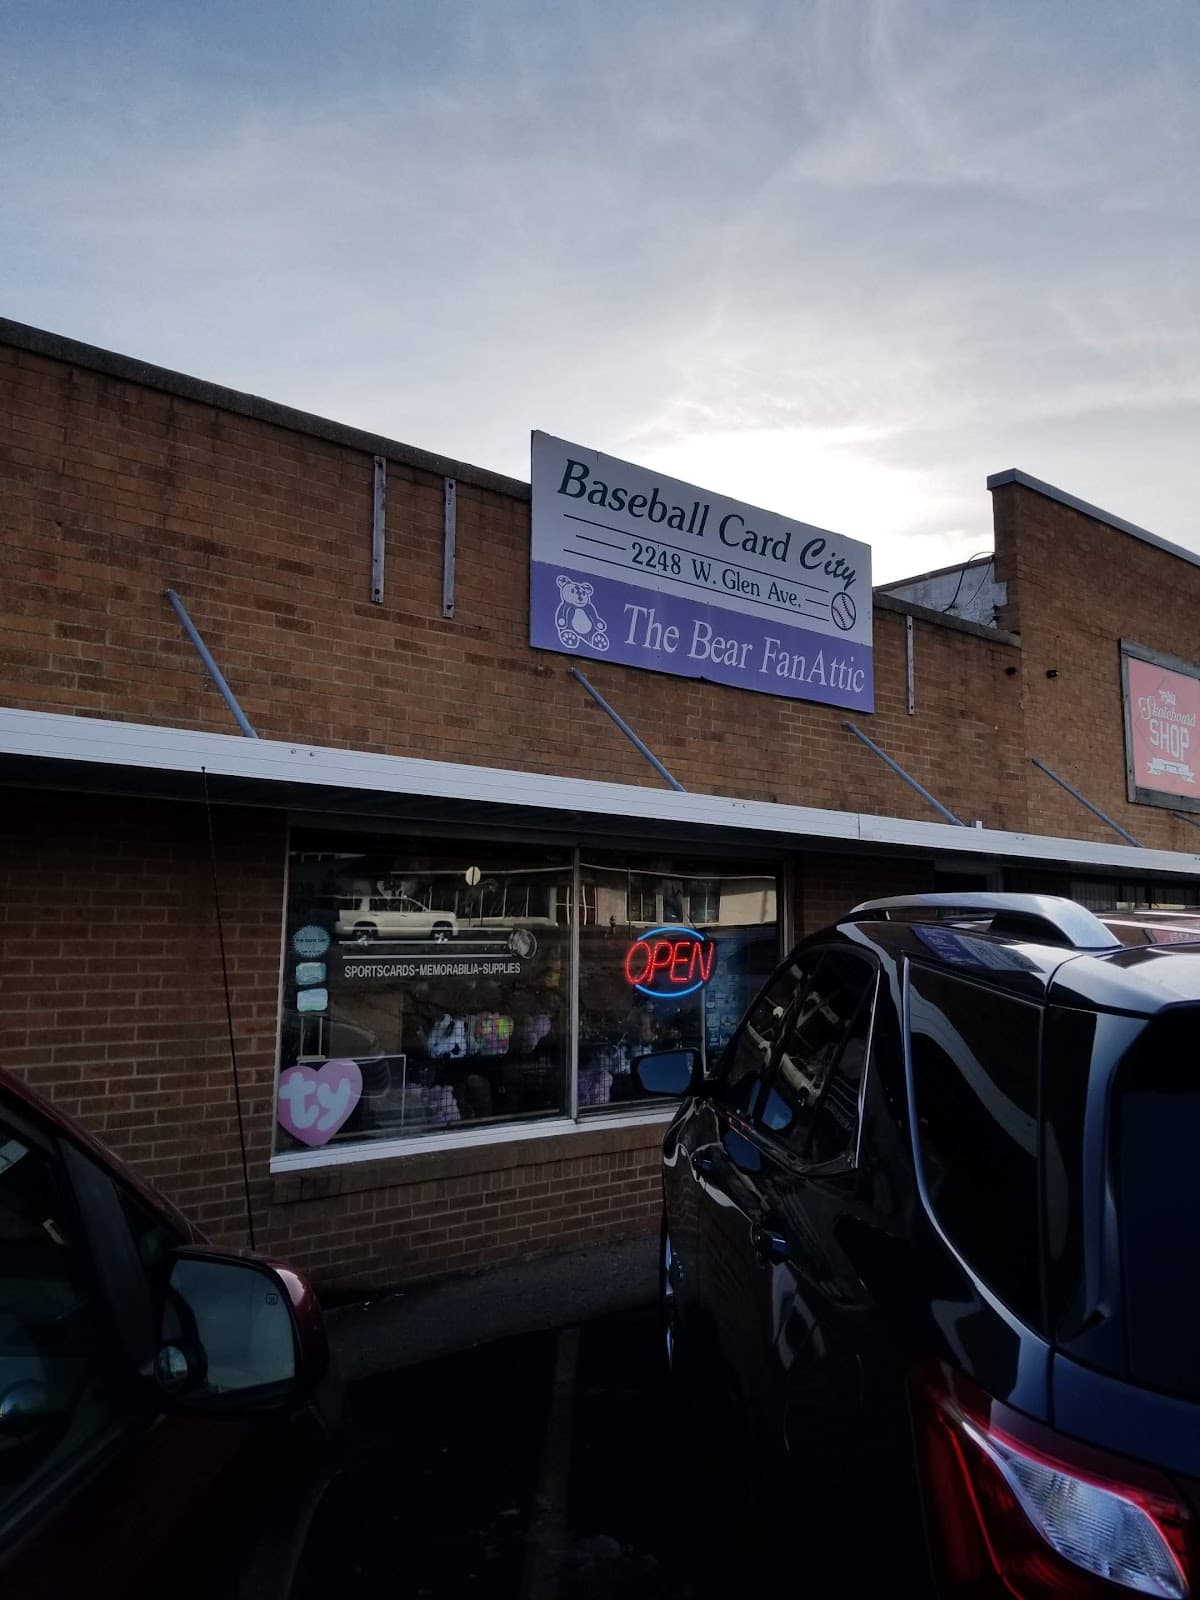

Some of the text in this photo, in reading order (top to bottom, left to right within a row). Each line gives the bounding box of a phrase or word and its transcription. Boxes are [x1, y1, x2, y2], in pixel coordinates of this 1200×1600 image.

[557, 459, 857, 590] Baseball Card City
[632, 542, 802, 608] 2248 W. Glen Ave.
[623, 604, 865, 694] The Bear FanAttic
[1149, 719, 1190, 761] SHOP
[625, 941, 715, 984] OPEN
[279, 1071, 350, 1132] ty
